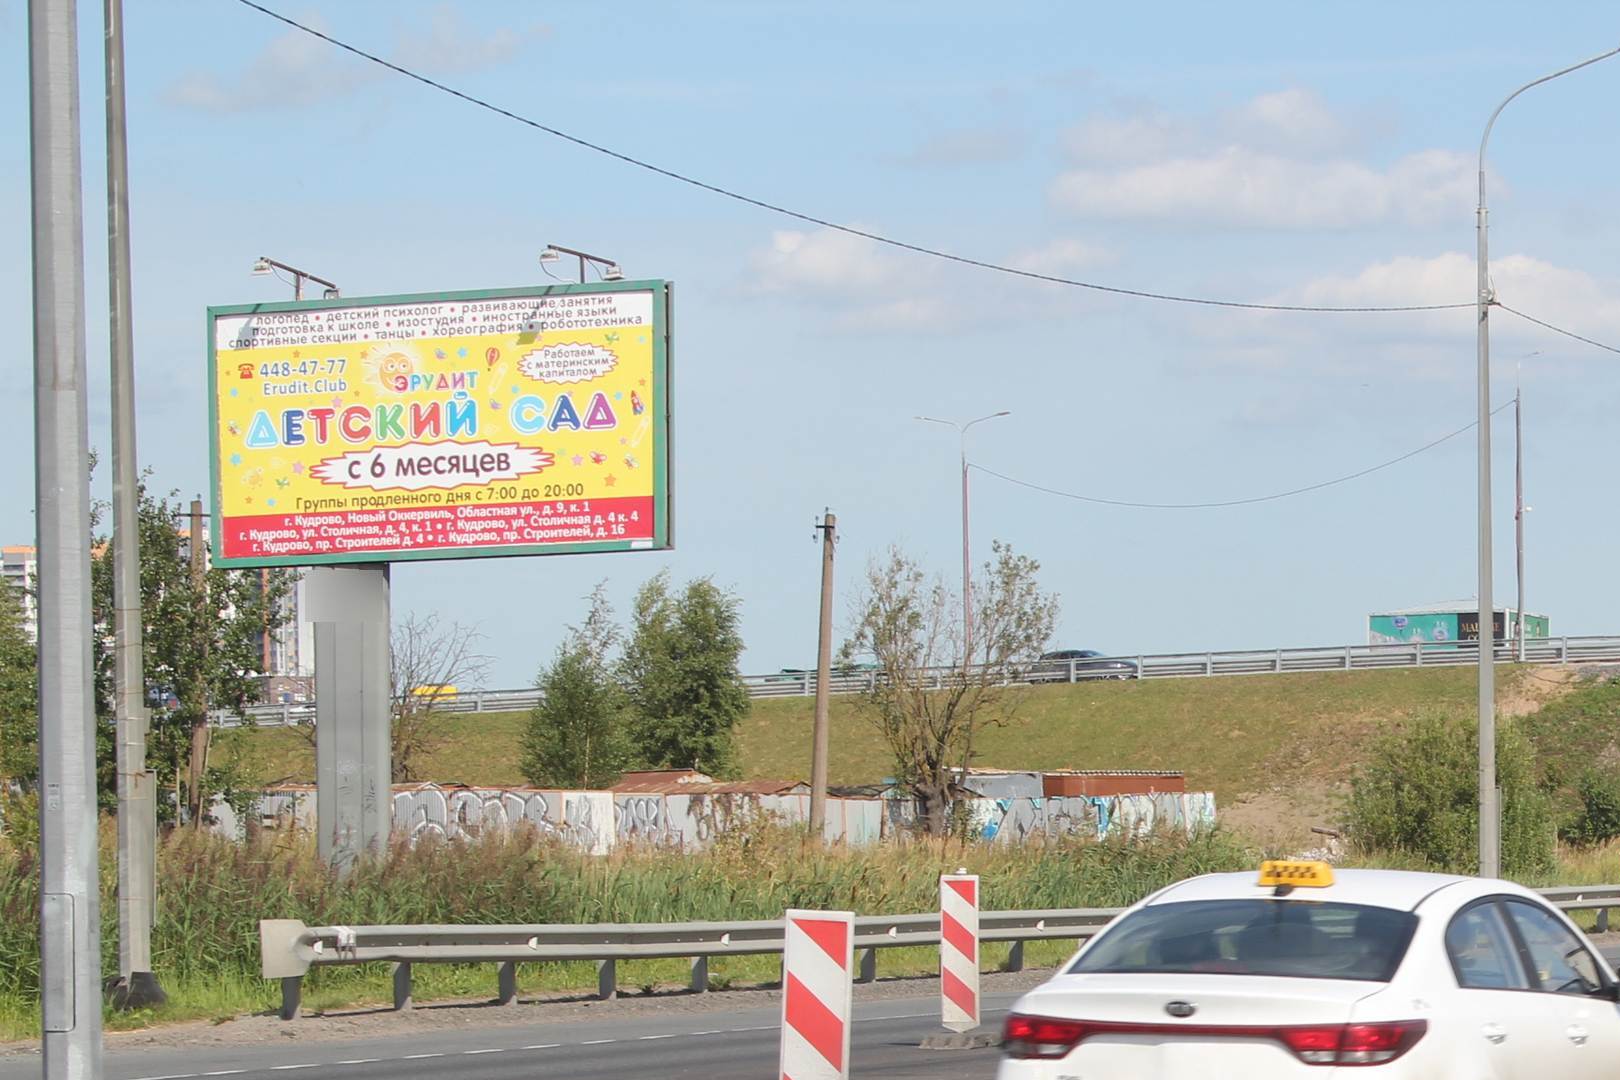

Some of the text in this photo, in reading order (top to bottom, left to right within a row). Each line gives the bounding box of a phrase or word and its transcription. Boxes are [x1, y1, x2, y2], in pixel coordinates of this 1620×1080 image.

[252, 306, 617, 337] подготовка к школе изостудия иностранные языки
[256, 297, 613, 325] логопед детский психолог развивающие занятия
[229, 316, 642, 350] спортивные секции танцы хореография робототехника
[260, 359, 346, 377] 448-47-77
[527, 357, 610, 370] с материнским
[544, 349, 595, 359] Работаем
[264, 379, 347, 396] Erudit.Club
[394, 371, 478, 392] ЭРУДИТ
[539, 368, 597, 379] капиталом
[245, 391, 617, 447] ДЕТСКИЙ САД
[348, 453, 511, 479] с 6 месяцев
[296, 483, 584, 512] Группы продленного дня с 7:00 до 20:00
[240, 511, 639, 543] г. Кудрово, ул. Столичная, д. 4, к. 1 г. Кудрово, ул. Столичная д. 4 к. 4
[284, 518, 292, 526] г.
[295, 515, 345, 529] Кудрово,
[348, 509, 386, 522] Новый
[388, 508, 454, 523] Оккервиль,
[457, 504, 518, 518] Областная
[542, 504, 554, 515] д.
[557, 502, 567, 514] 9,
[570, 503, 580, 512] к.
[583, 501, 590, 512] 1
[253, 524, 625, 553] г. Кудрово, пр. Строителей д. 4 г. Кудрово, пр. Строителей, д. 16
